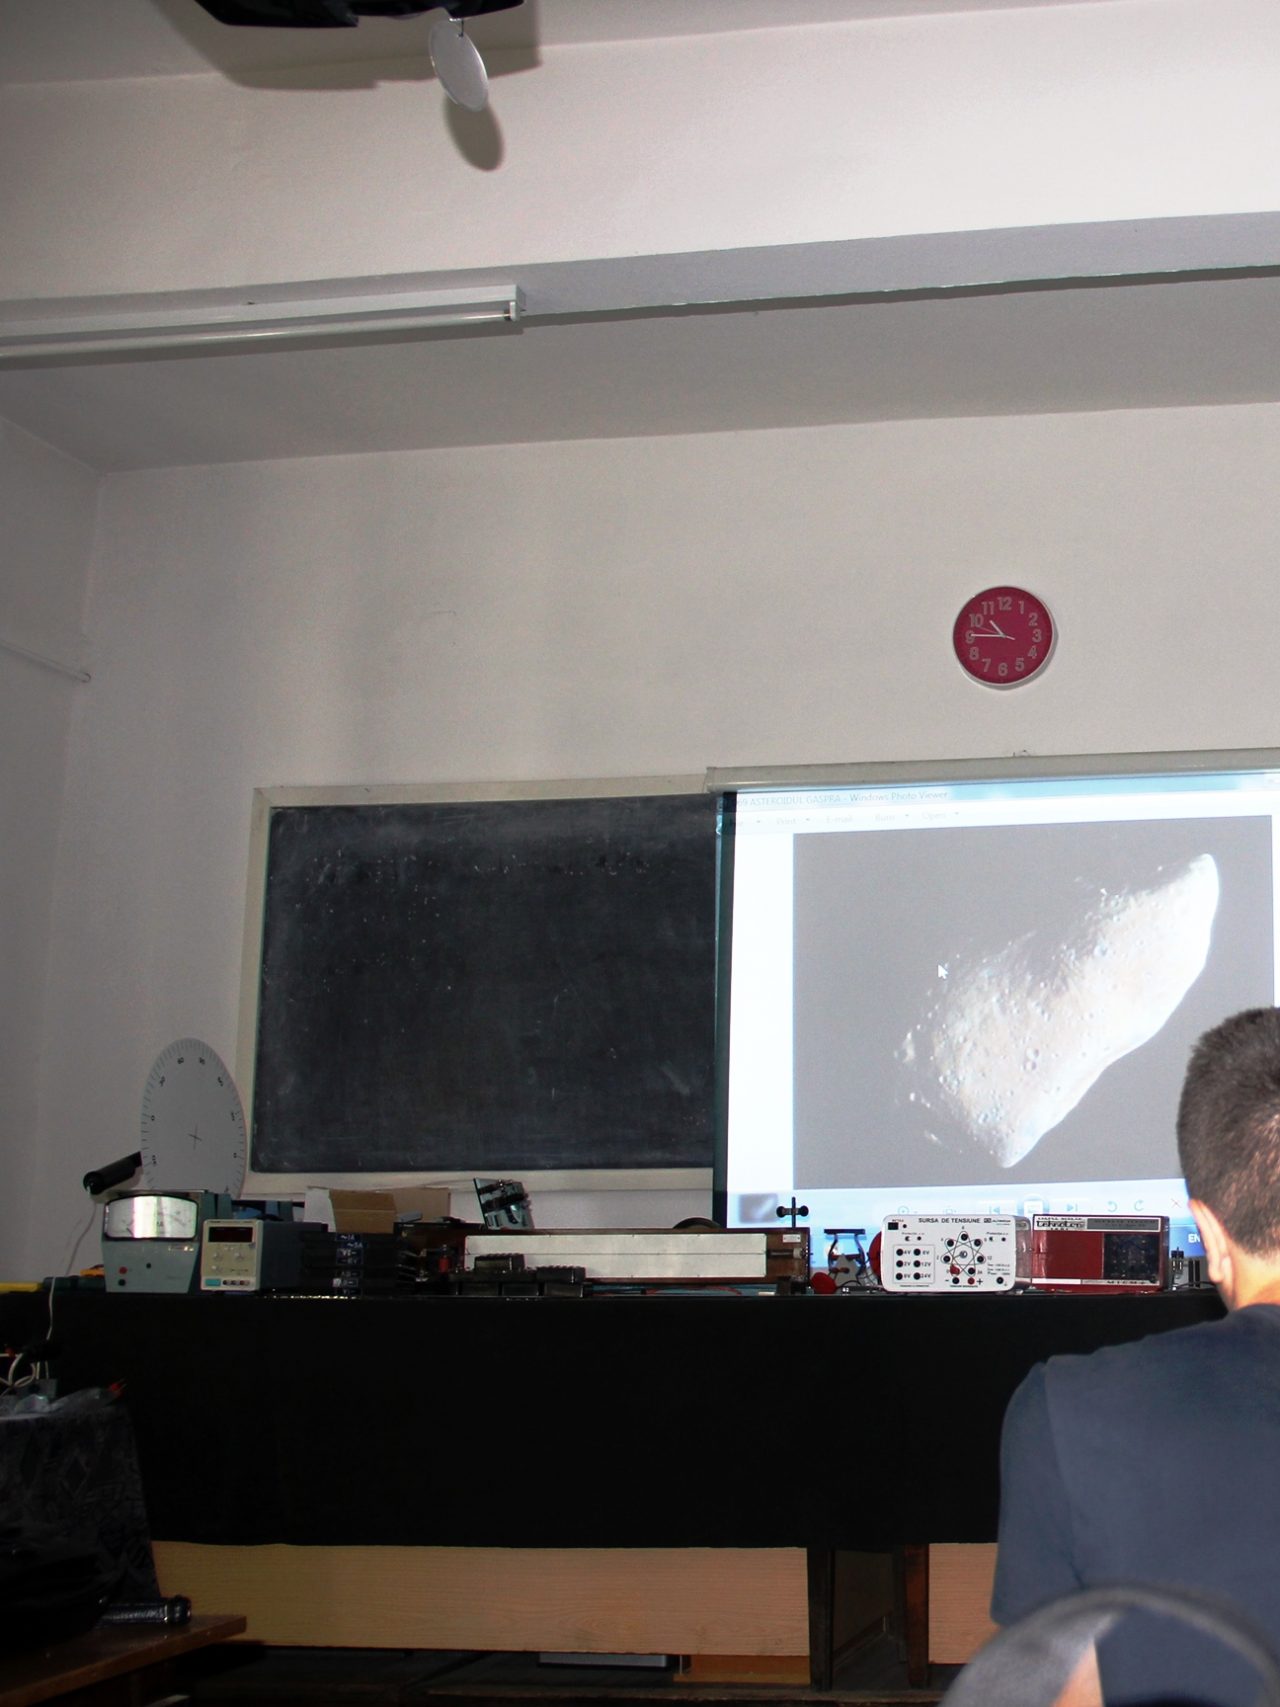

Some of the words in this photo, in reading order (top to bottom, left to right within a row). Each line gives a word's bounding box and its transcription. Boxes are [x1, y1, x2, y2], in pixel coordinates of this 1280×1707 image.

[981, 601, 995, 615] 11
[997, 596, 1012, 611] 12
[1018, 600, 1025, 615] 1
[969, 613, 984, 628] 10
[1028, 612, 1038, 627] 2
[965, 630, 976, 644] 9
[1032, 629, 1042, 643] 3
[969, 646, 979, 660] 8
[1027, 645, 1037, 659] 4
[982, 658, 991, 673] 7
[998, 662, 1008, 676] 6
[1015, 657, 1025, 672] 5
[850, 791, 889, 803] Windows
[891, 790, 917, 802] Photo
[918, 789, 948, 801] Viewer
